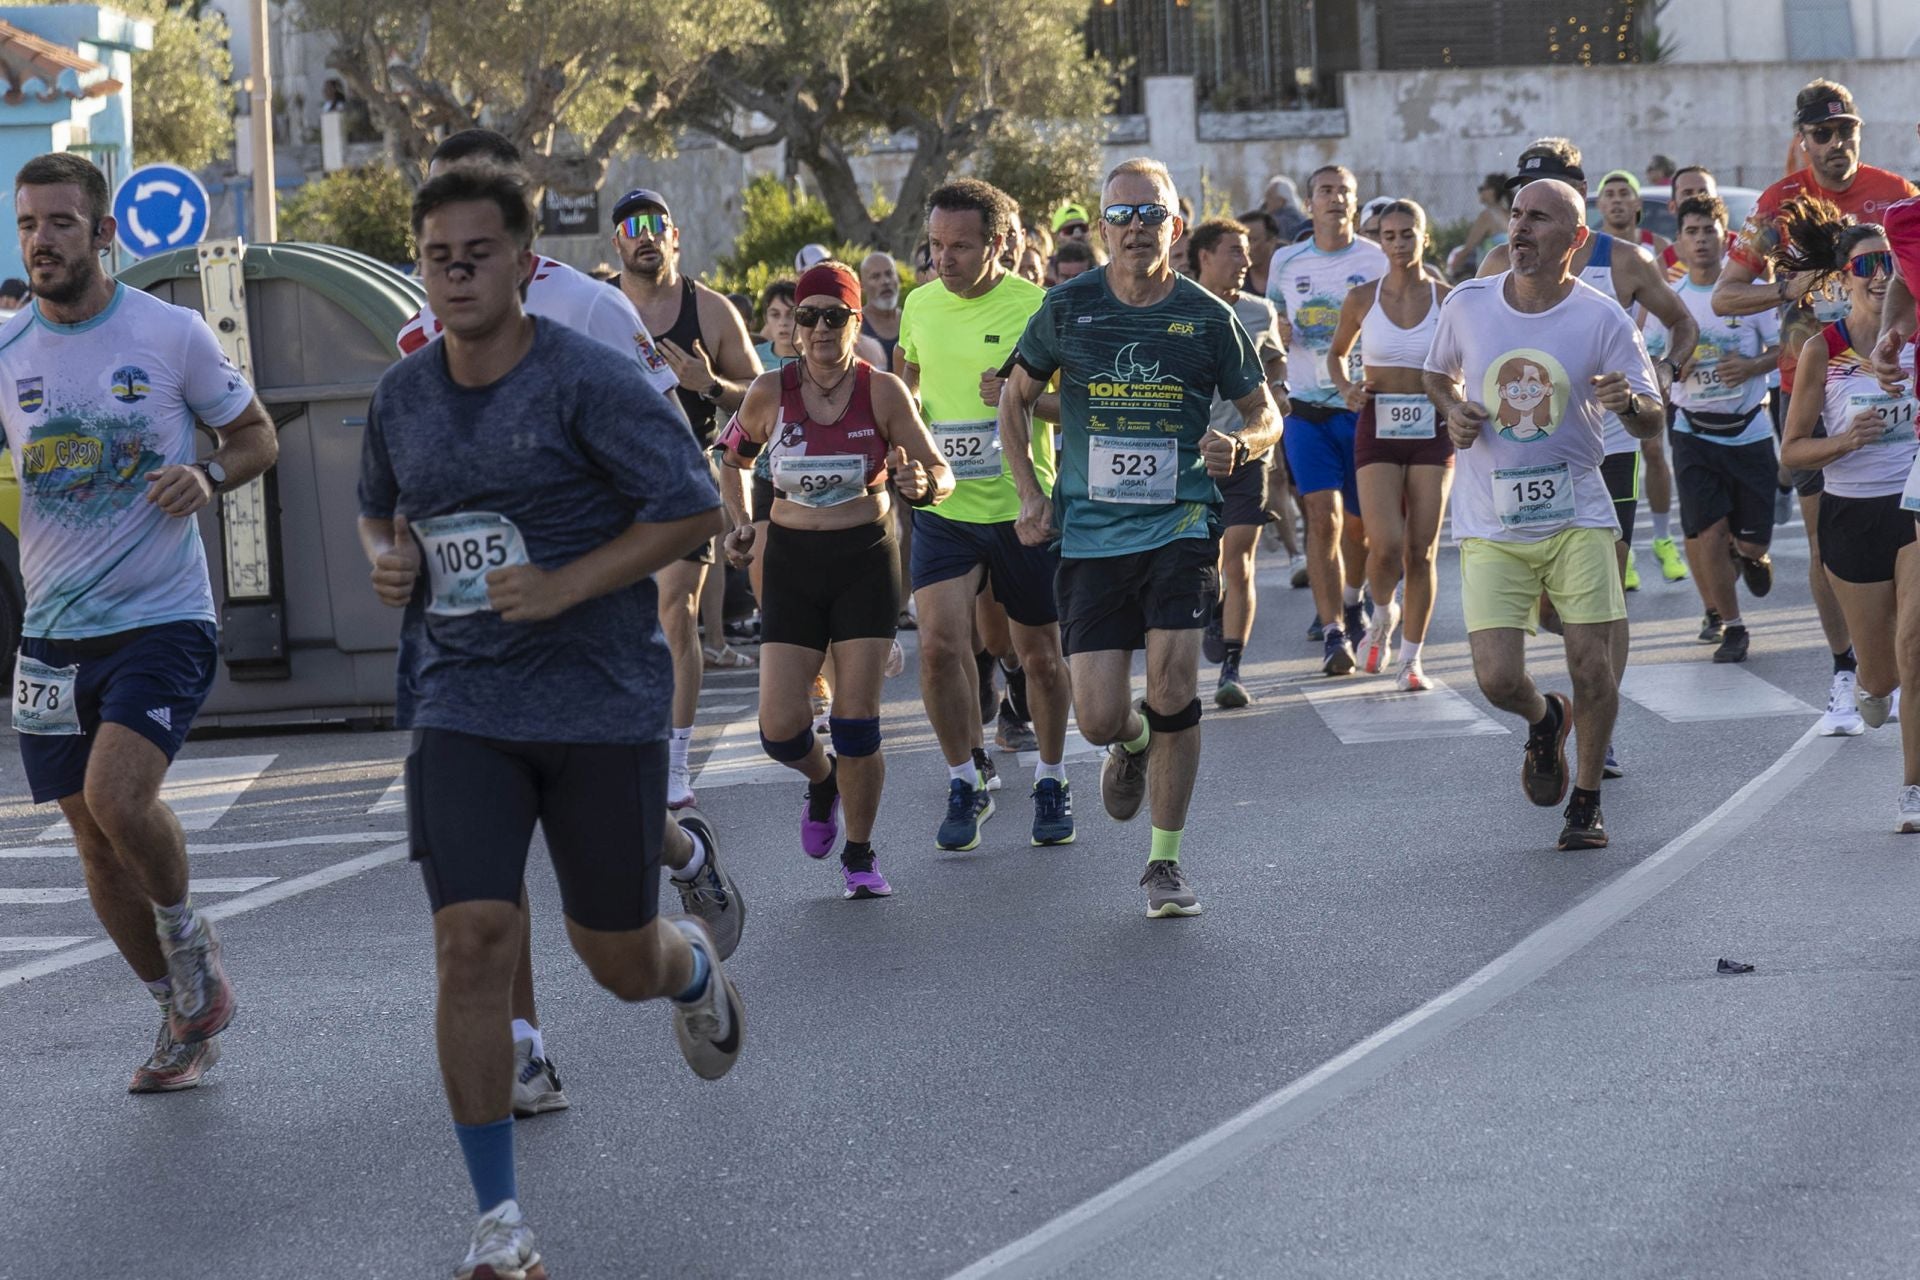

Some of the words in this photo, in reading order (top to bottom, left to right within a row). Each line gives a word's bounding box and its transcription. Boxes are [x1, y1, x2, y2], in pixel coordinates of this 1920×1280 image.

[1088, 382, 1130, 397] 10K
[1131, 383, 1183, 392] NOCTURNA
[1131, 391, 1184, 400] ALBACETE
[1391, 407, 1421, 422] 980
[24, 444, 45, 471] XV
[55, 439, 101, 467] CROSS
[944, 436, 982, 457] 552
[1112, 453, 1157, 476] 523
[1120, 479, 1147, 487] JOSAN
[1513, 479, 1556, 502] 153
[436, 534, 507, 575] 1085
[18, 680, 60, 711] 378
